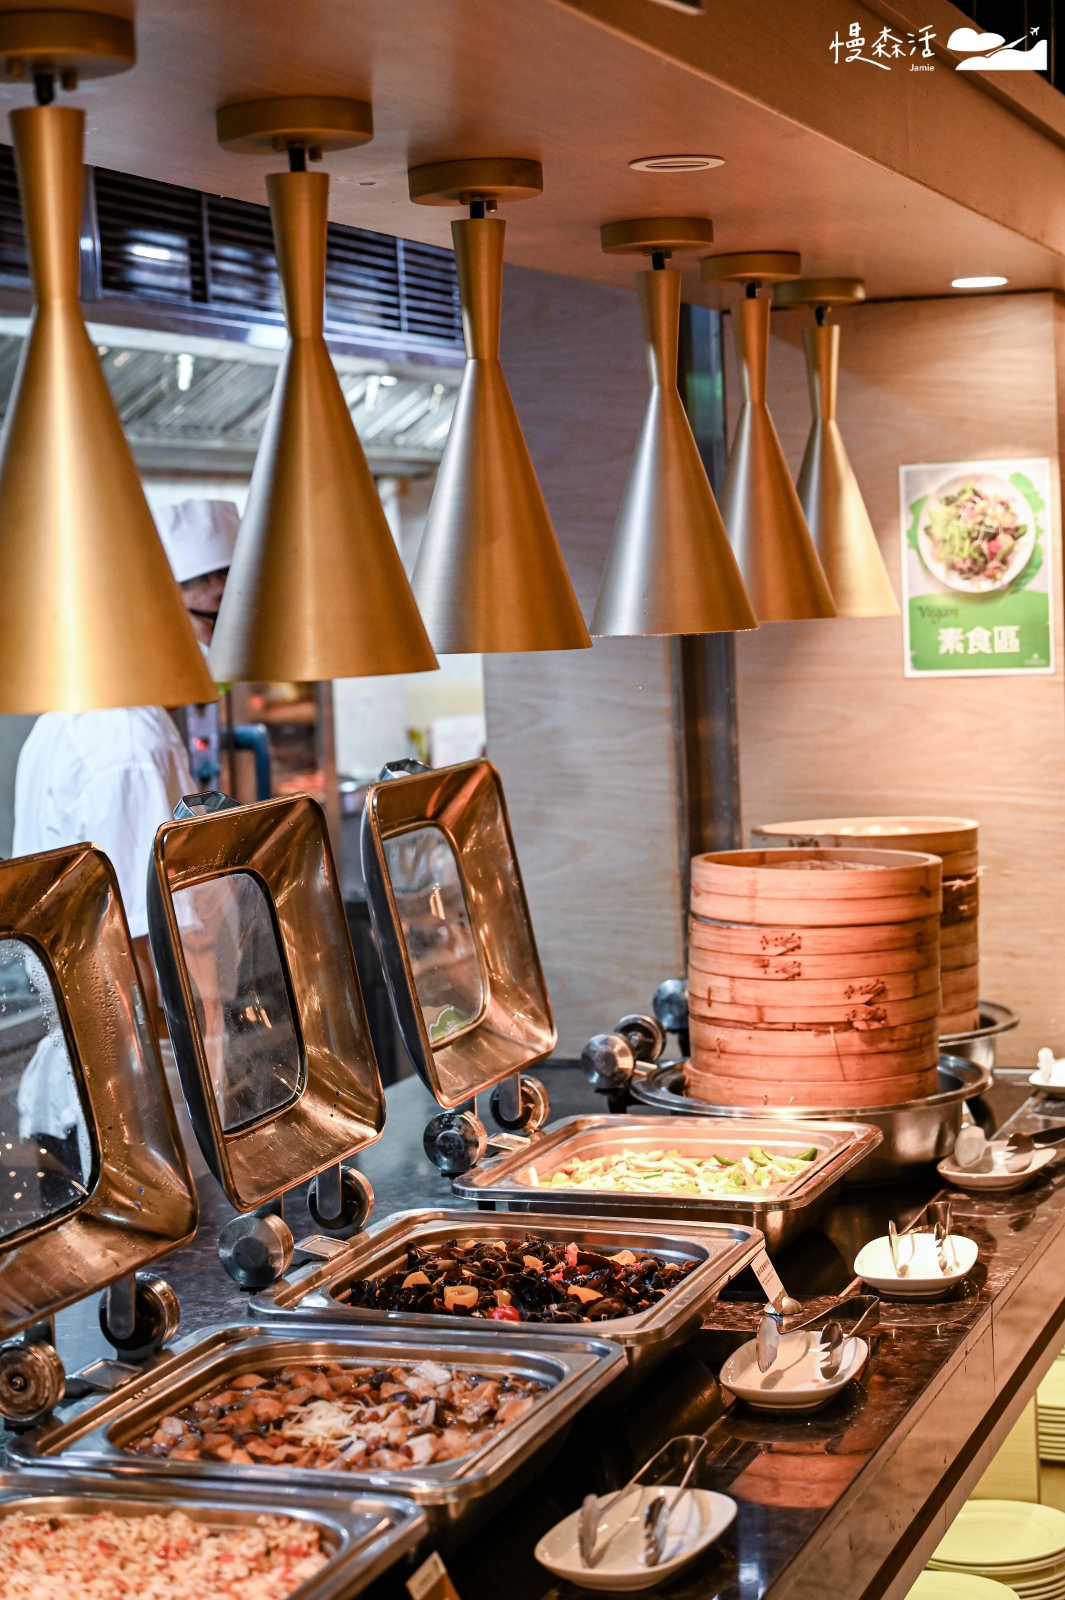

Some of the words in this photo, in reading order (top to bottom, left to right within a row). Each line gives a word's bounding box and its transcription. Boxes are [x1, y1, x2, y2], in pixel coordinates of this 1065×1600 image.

[918, 606, 958, 624] Vegan
[937, 626, 1020, 655] 素食區
